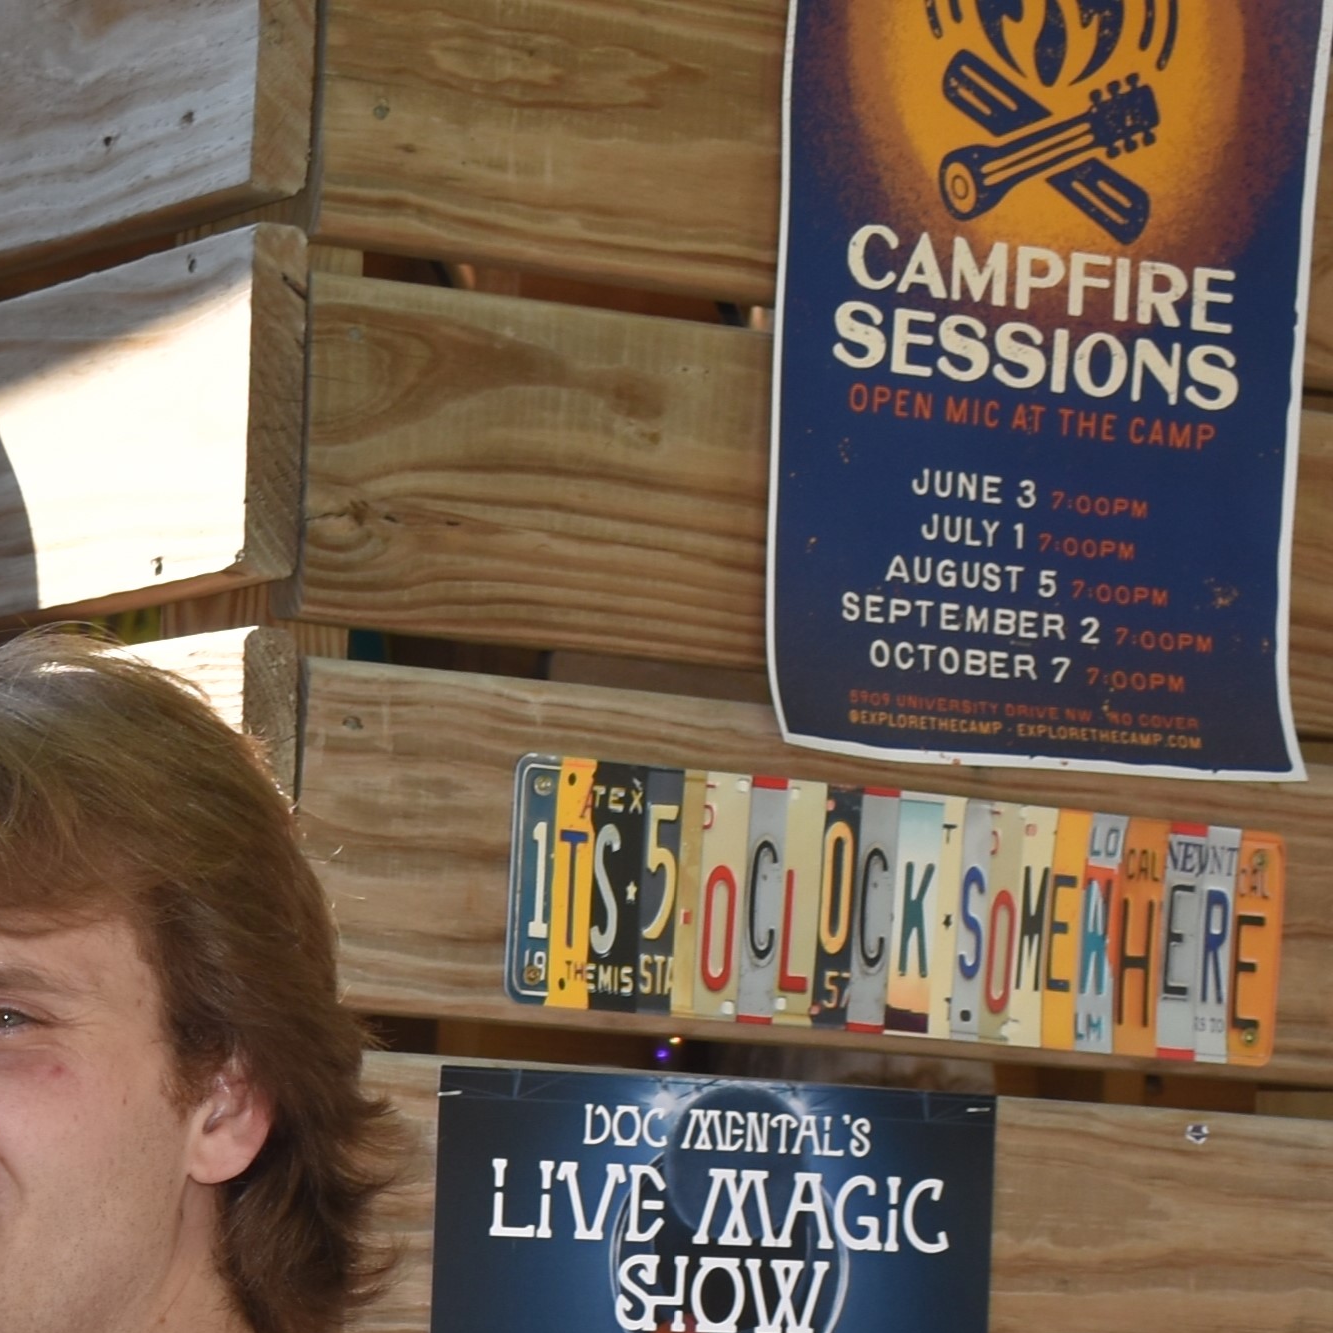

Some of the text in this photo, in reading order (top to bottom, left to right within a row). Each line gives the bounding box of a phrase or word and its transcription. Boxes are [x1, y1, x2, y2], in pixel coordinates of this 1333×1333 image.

[847, 224, 1236, 334] CAMPFIRE
[833, 301, 1239, 410] SESSIONS
[849, 382, 1216, 451] OPEN MIC AT THE CAMP
[912, 468, 1148, 518] JUNE 3 7:00PM
[921, 514, 1135, 560] JULY 1 7:00PM
[885, 555, 1169, 607] AUGUST 5 7:00PM
[842, 592, 1213, 654] SEPTEMBER 2 7:00PM
[870, 639, 1185, 693] OCTOBER 7 7:00PM
[896, 694, 998, 716] UNIVERSITY
[1005, 703, 1060, 721] DRIVE
[1065, 708, 1092, 723] NW
[1137, 713, 1199, 730] COVER
[1017, 723, 1203, 749] EXPLORETHECAMP.COM
[643, 804, 679, 940] 5
[582, 1103, 871, 1158] DOC MENTAL'S
[489, 1158, 950, 1254] LIVE MAGIC
